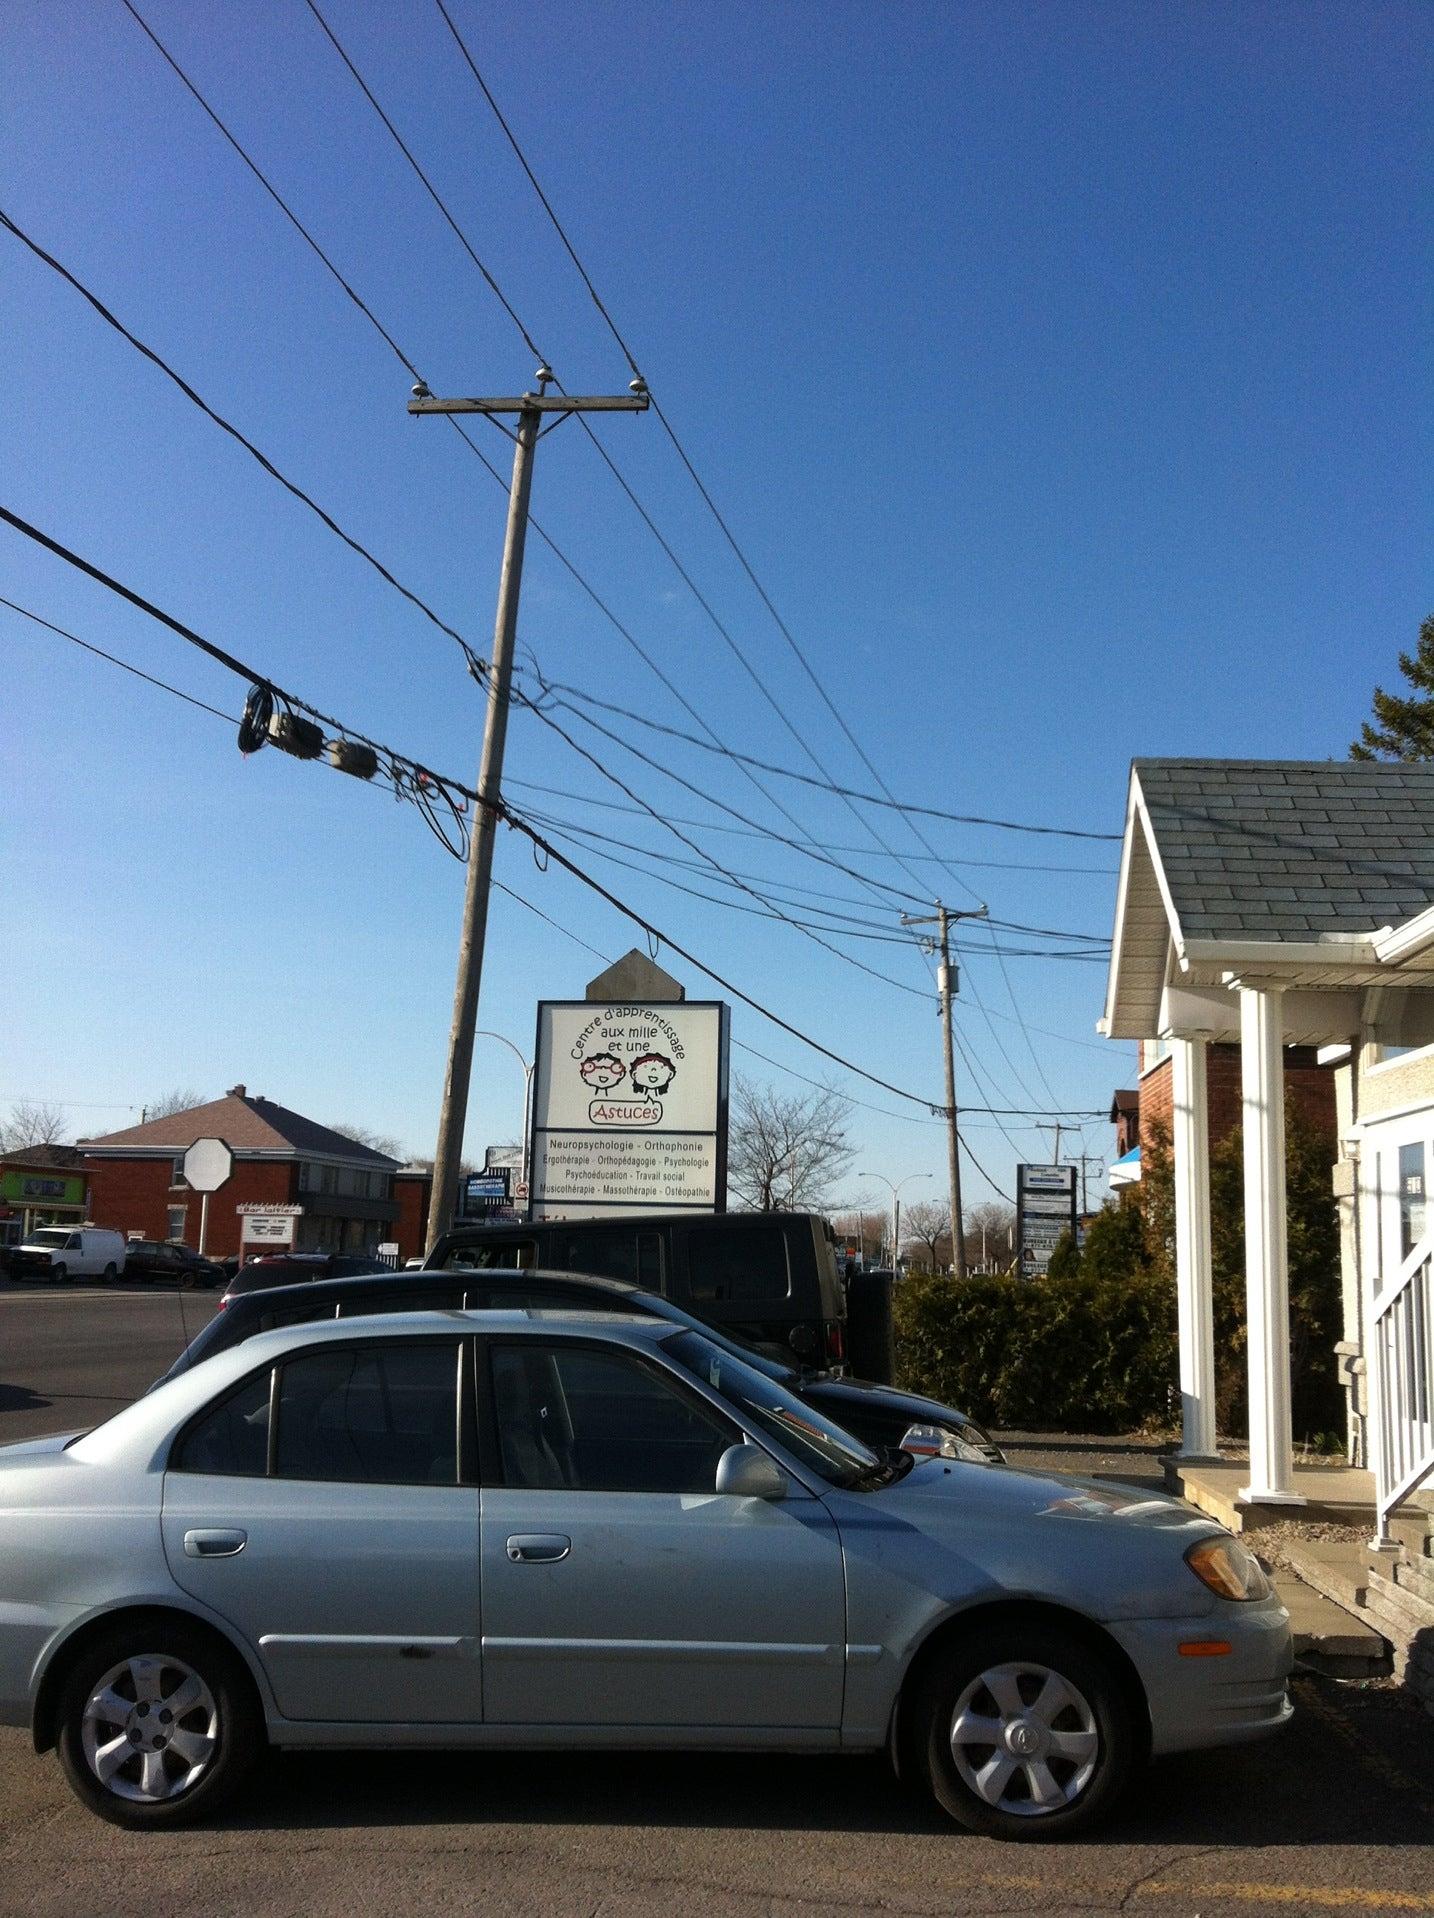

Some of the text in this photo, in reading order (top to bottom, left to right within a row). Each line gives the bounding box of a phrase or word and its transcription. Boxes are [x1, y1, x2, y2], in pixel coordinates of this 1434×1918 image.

[571, 1007, 685, 1060] Centre d'apprentissage
[601, 1026, 658, 1037] aux mille
[608, 1042, 650, 1052] et une
[593, 1104, 659, 1120] Astuces
[550, 1139, 703, 1152] Neuropsychologie Orthophonie
[543, 1154, 709, 1169] Ergothérapie Orthopédagogie Psychologie
[565, 1169, 685, 1181] Psychoéducation Travail social
[540, 1184, 710, 1197] Musicothérapie Massothérapie Ostéopathie
